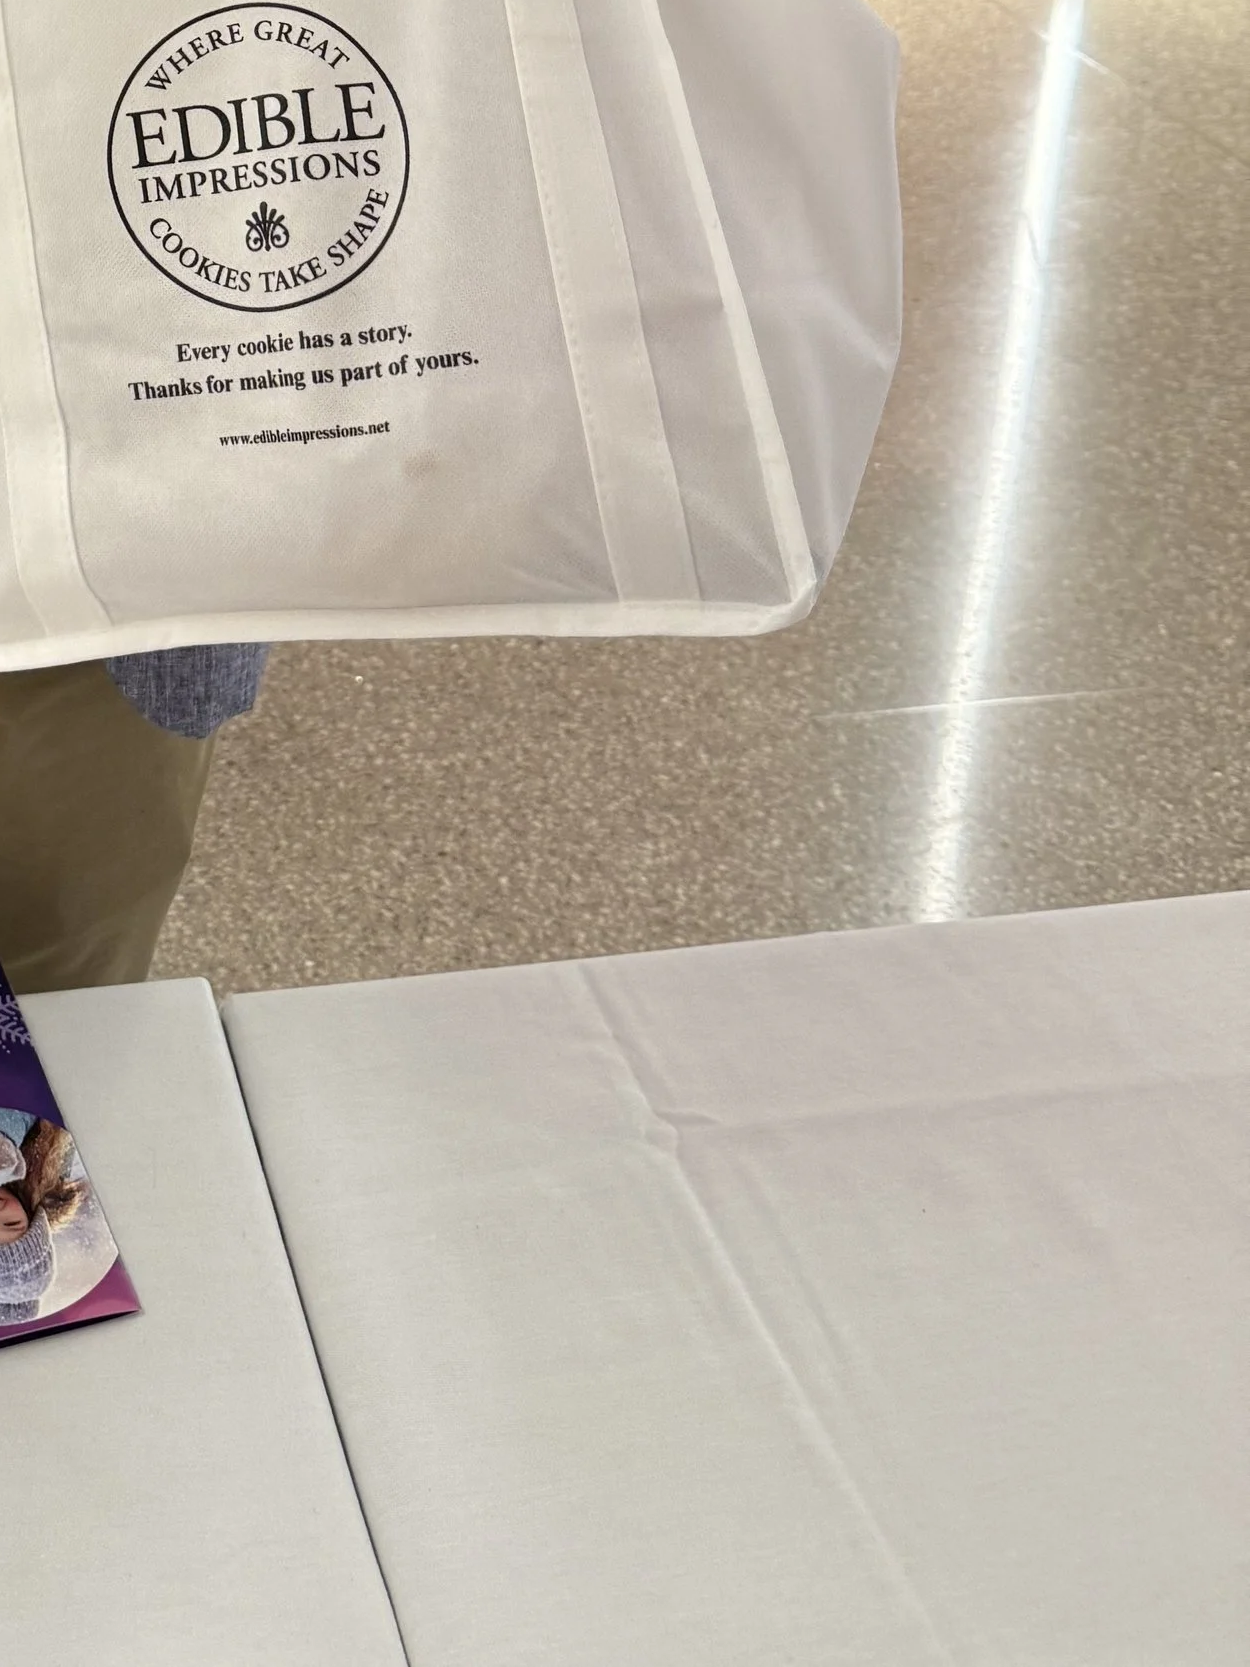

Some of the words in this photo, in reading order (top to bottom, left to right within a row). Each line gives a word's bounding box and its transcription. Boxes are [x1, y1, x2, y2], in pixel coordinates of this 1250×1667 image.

[145, 22, 245, 93] WHERE
[253, 20, 350, 70] GREAT
[126, 81, 386, 169] EDIBLE
[138, 149, 381, 204] IMPRESSIONS
[149, 217, 252, 292] COOKIES
[259, 257, 328, 294] TAKE
[327, 188, 389, 267] SHAPE
[176, 341, 230, 363] Every
[237, 335, 294, 356] cookie
[299, 331, 334, 350] has
[340, 333, 353, 347] a
[358, 322, 412, 347] story.
[128, 377, 202, 401] Thanks
[206, 374, 233, 394] for
[240, 369, 307, 393] making
[312, 369, 334, 385] us
[341, 363, 383, 387] part
[389, 357, 408, 376] of
[415, 349, 479, 377] yours.
[219, 420, 390, 447] www.edibleimpressions.net
